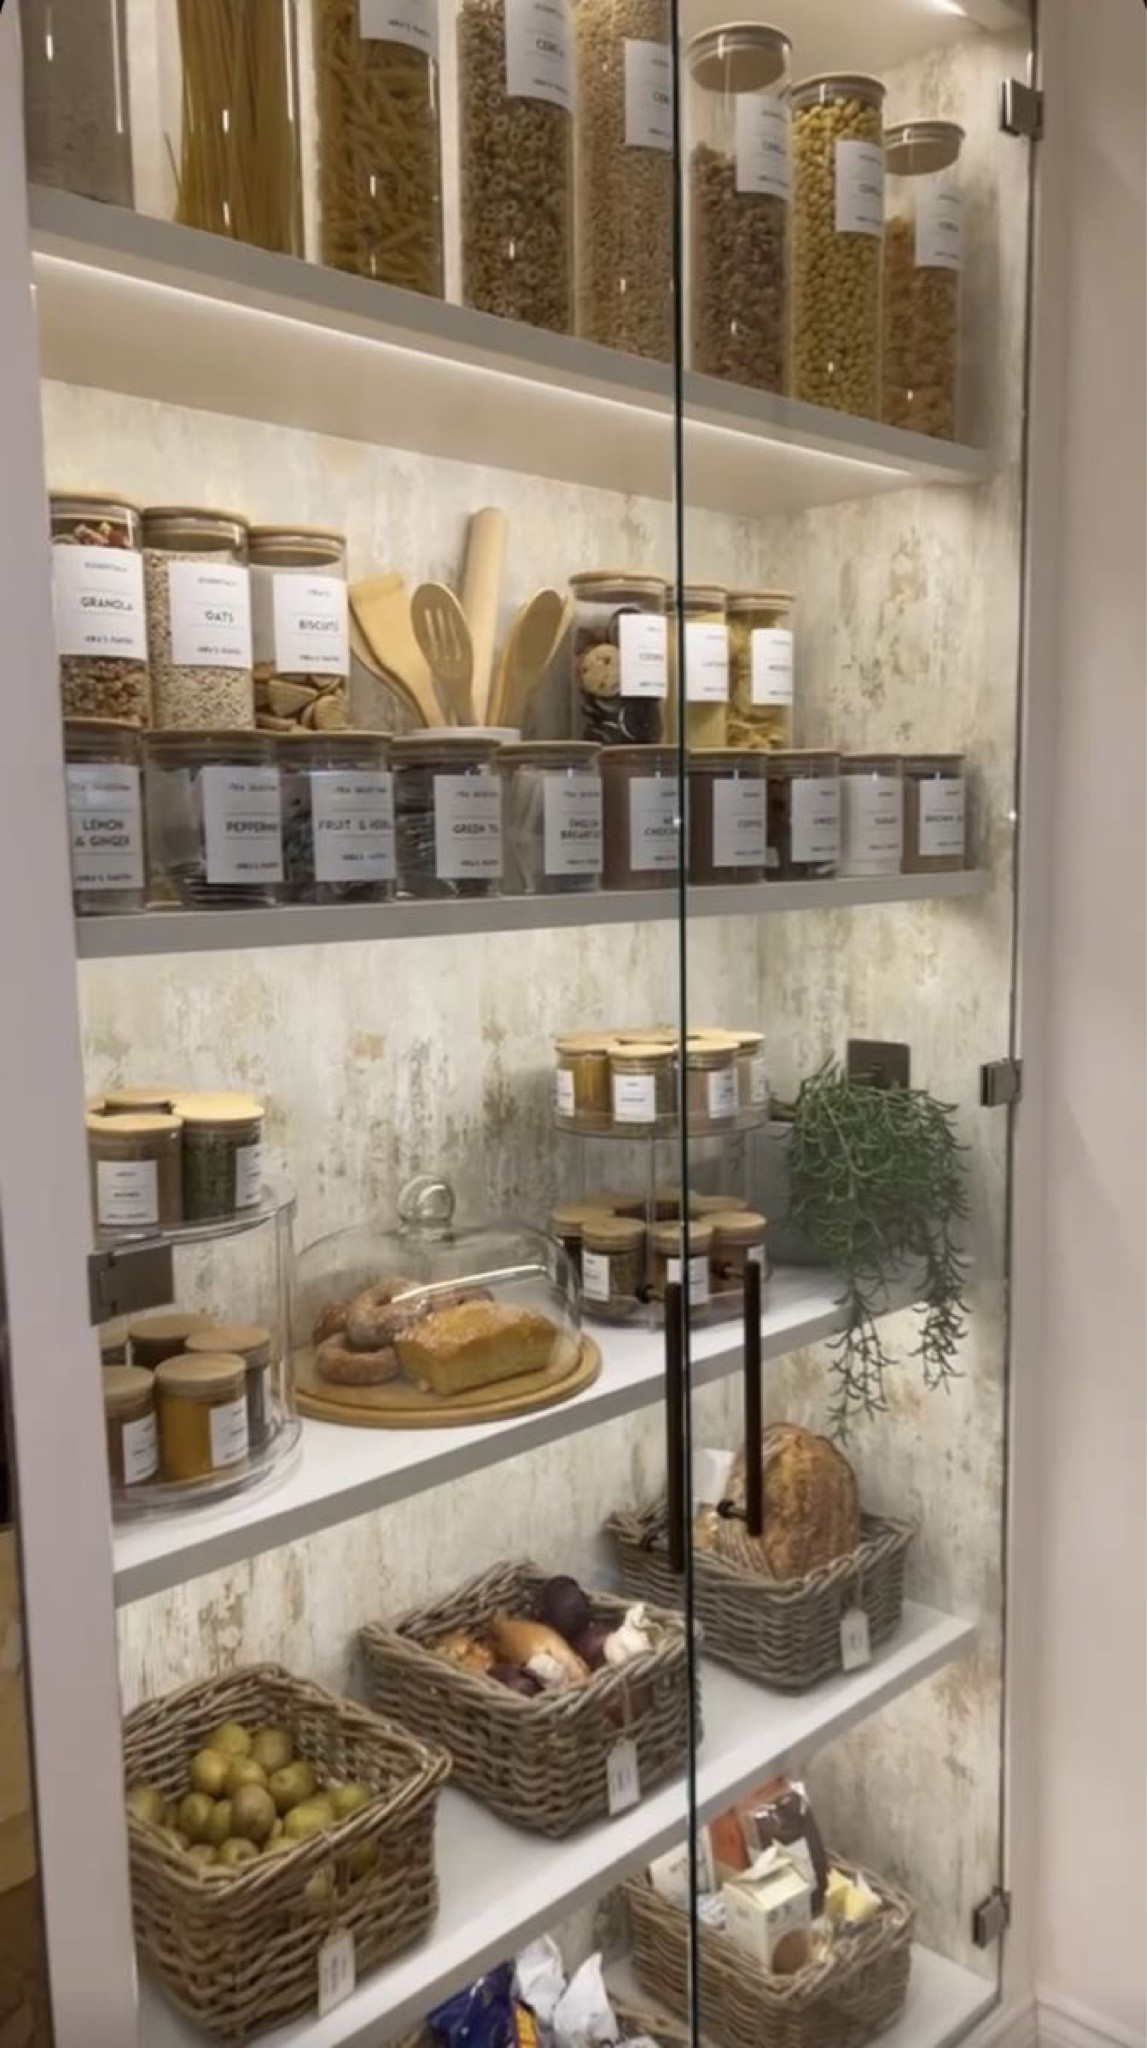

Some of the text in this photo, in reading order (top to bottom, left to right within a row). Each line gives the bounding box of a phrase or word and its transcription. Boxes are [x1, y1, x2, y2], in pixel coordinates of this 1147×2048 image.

[81, 596, 134, 612] GRANOLA
[204, 609, 235, 624] OATS
[298, 618, 340, 632] BISCUITS
[82, 819, 124, 832] LEMON
[318, 819, 352, 832] FRUIT
[451, 823, 486, 834] GREEN
[74, 835, 130, 847] & GINGER
